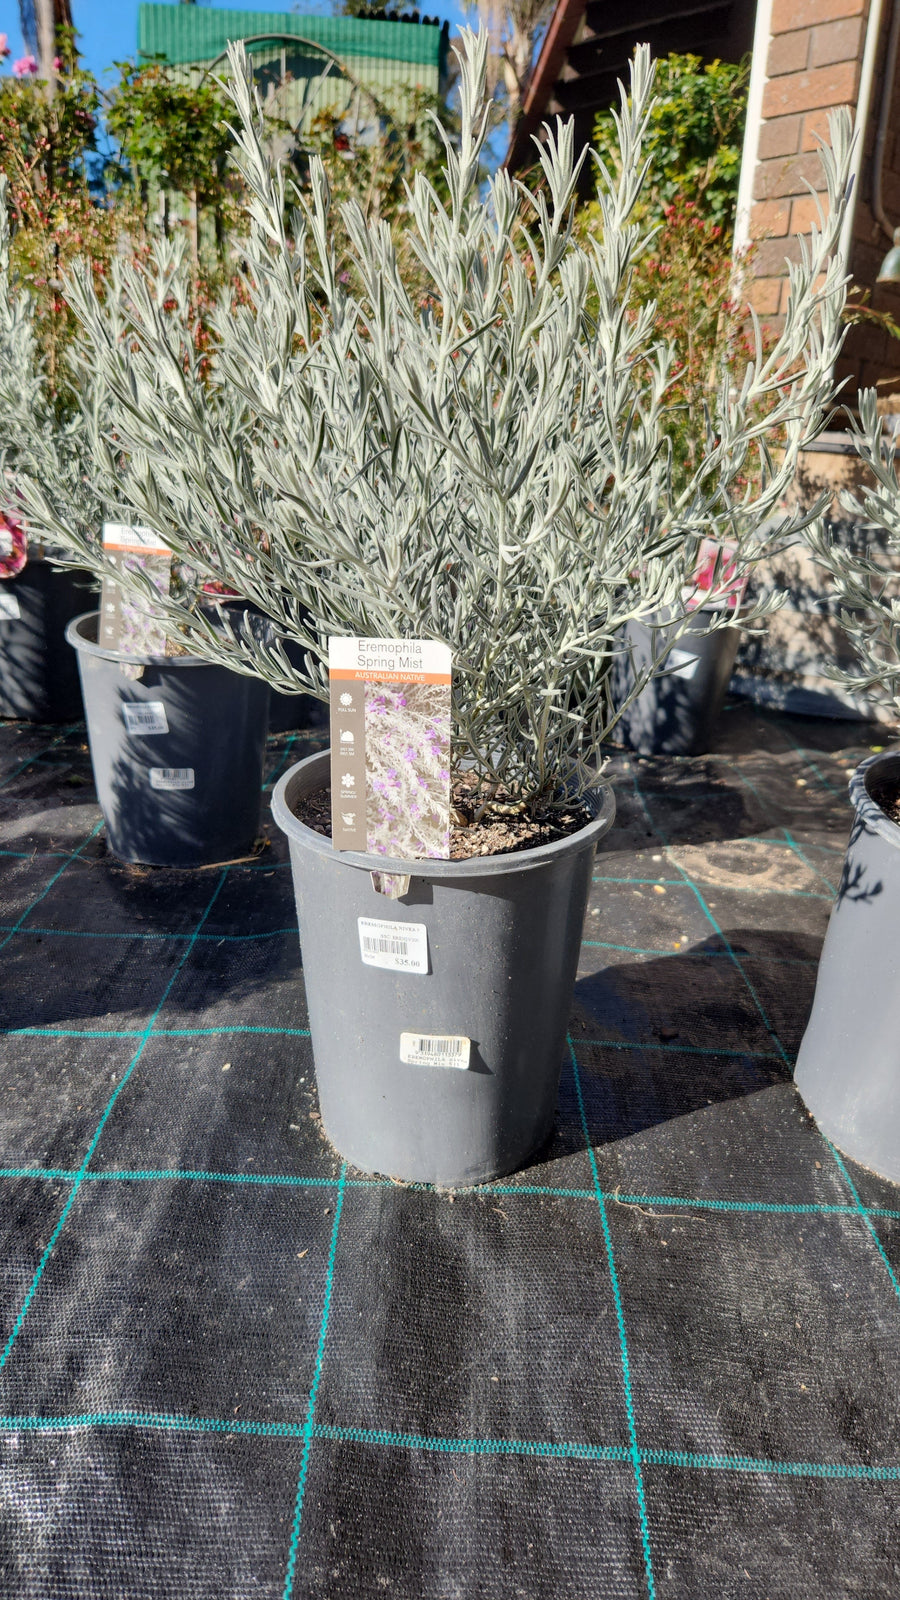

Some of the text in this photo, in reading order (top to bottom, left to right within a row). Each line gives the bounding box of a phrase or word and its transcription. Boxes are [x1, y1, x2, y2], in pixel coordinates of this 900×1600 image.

[358, 640, 422, 655] Eremophila
[357, 654, 423, 671] Spring Mist
[355, 671, 425, 681] AUSTRALIAN NATIVE
[361, 921, 398, 930] EREMOPHILA
[395, 957, 420, 968] $35.00
